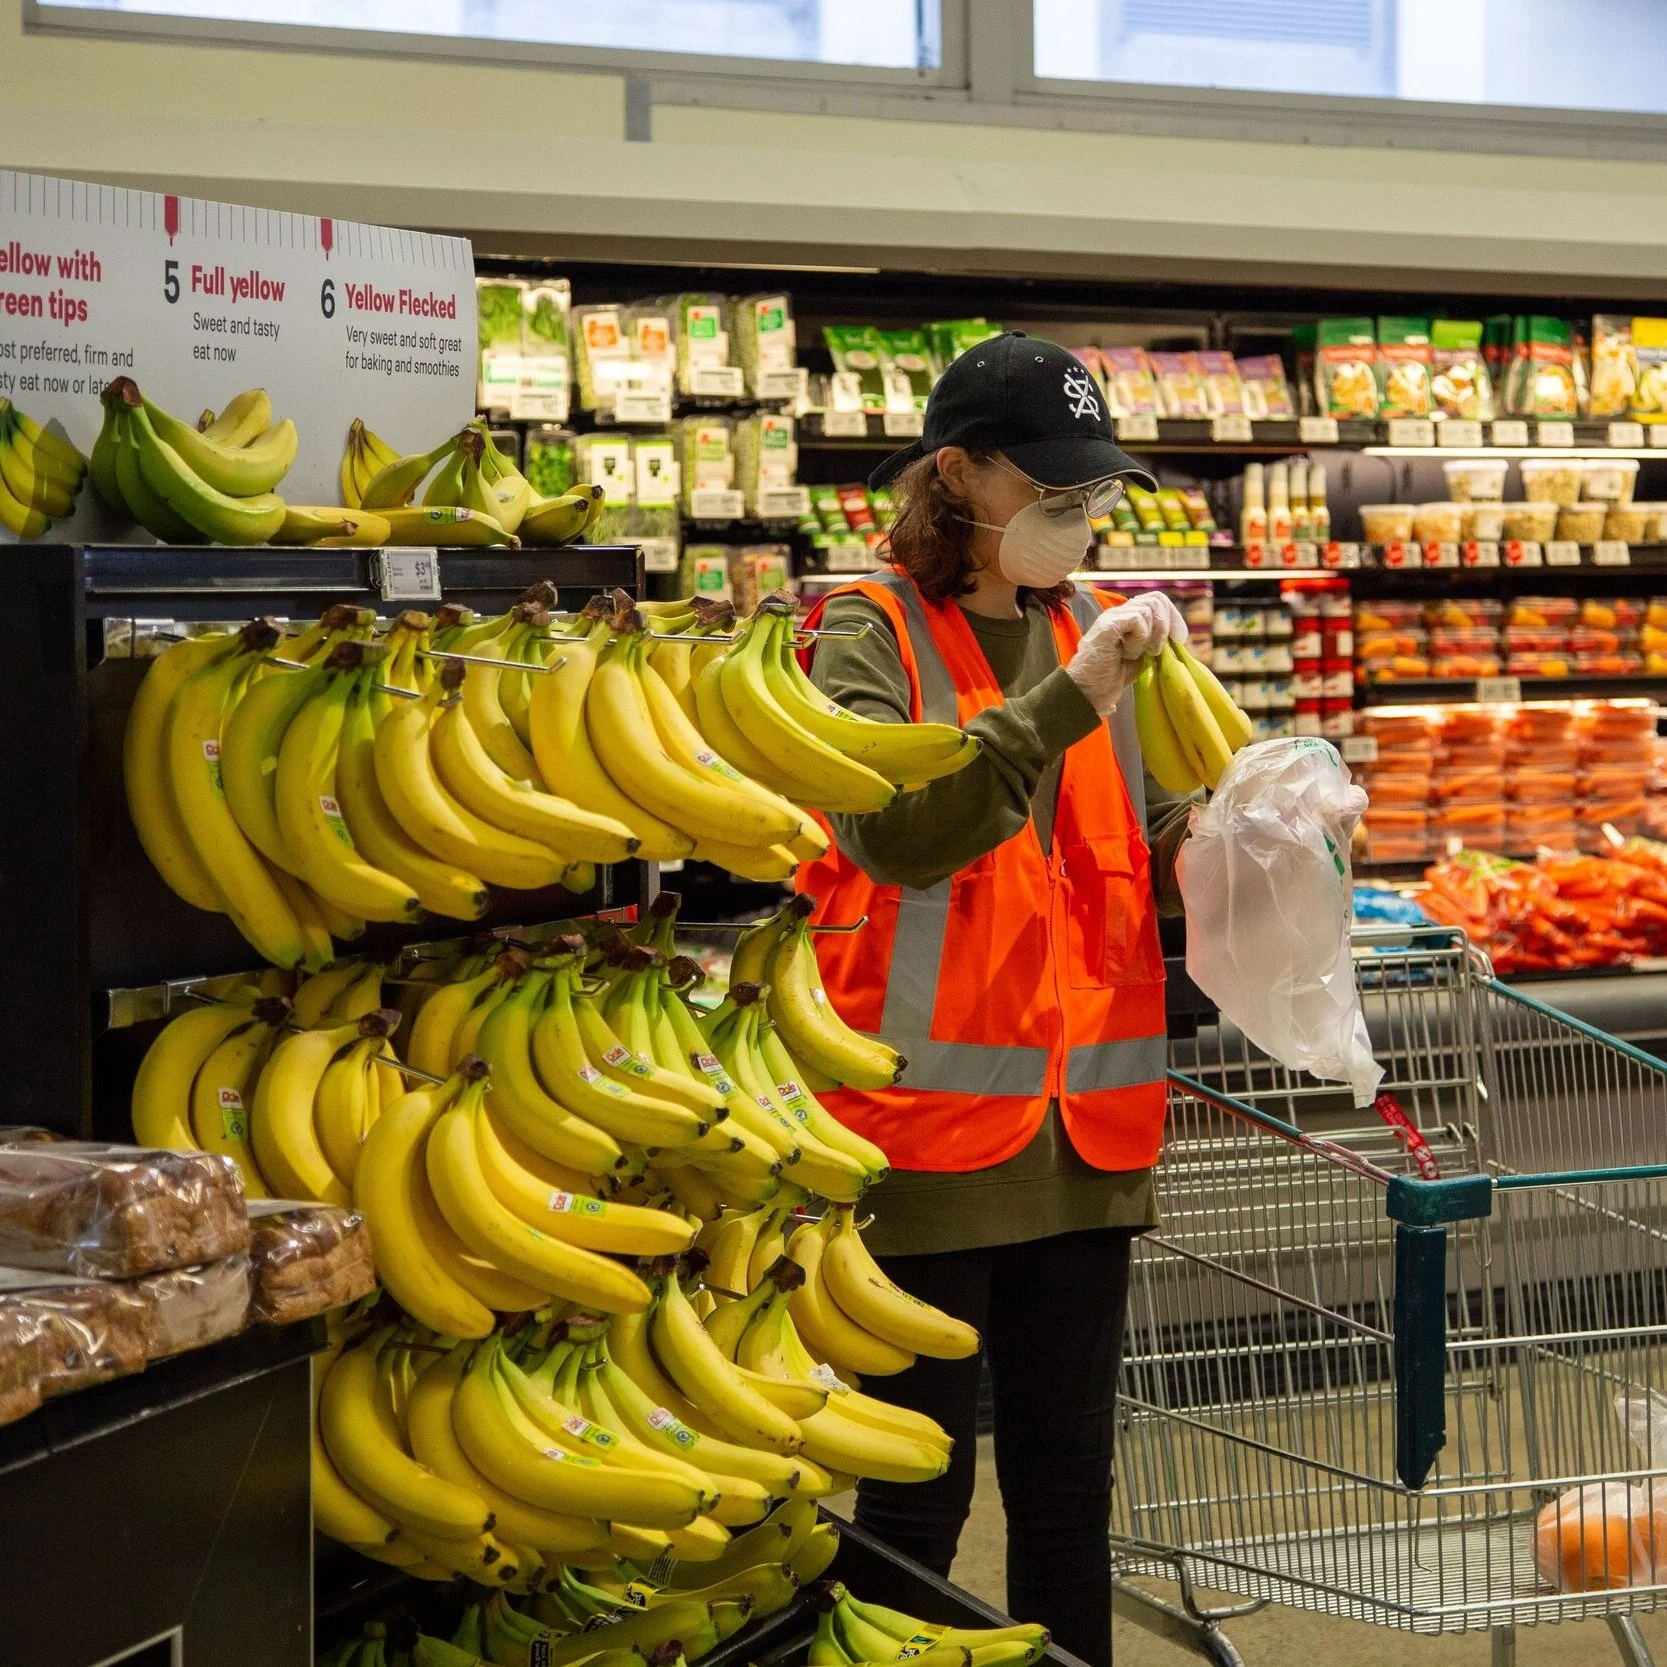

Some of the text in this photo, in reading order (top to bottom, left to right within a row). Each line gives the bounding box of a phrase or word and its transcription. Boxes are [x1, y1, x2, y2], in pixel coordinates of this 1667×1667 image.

[0, 241, 101, 282] ellow with
[164, 259, 285, 304] 5 Full yellow
[0, 288, 88, 327] reen tips
[320, 278, 456, 319] 6 Yellow Flecked
[193, 311, 280, 342] Sweet and tasty
[346, 325, 462, 354] Very sweet and soft great
[0, 340, 134, 368] ost preferred, firm and
[193, 343, 236, 362] eat now
[345, 351, 460, 377] for baking and smoothies
[19, 373, 40, 392] eat
[44, 378, 71, 393] now
[72, 381, 86, 394] or
